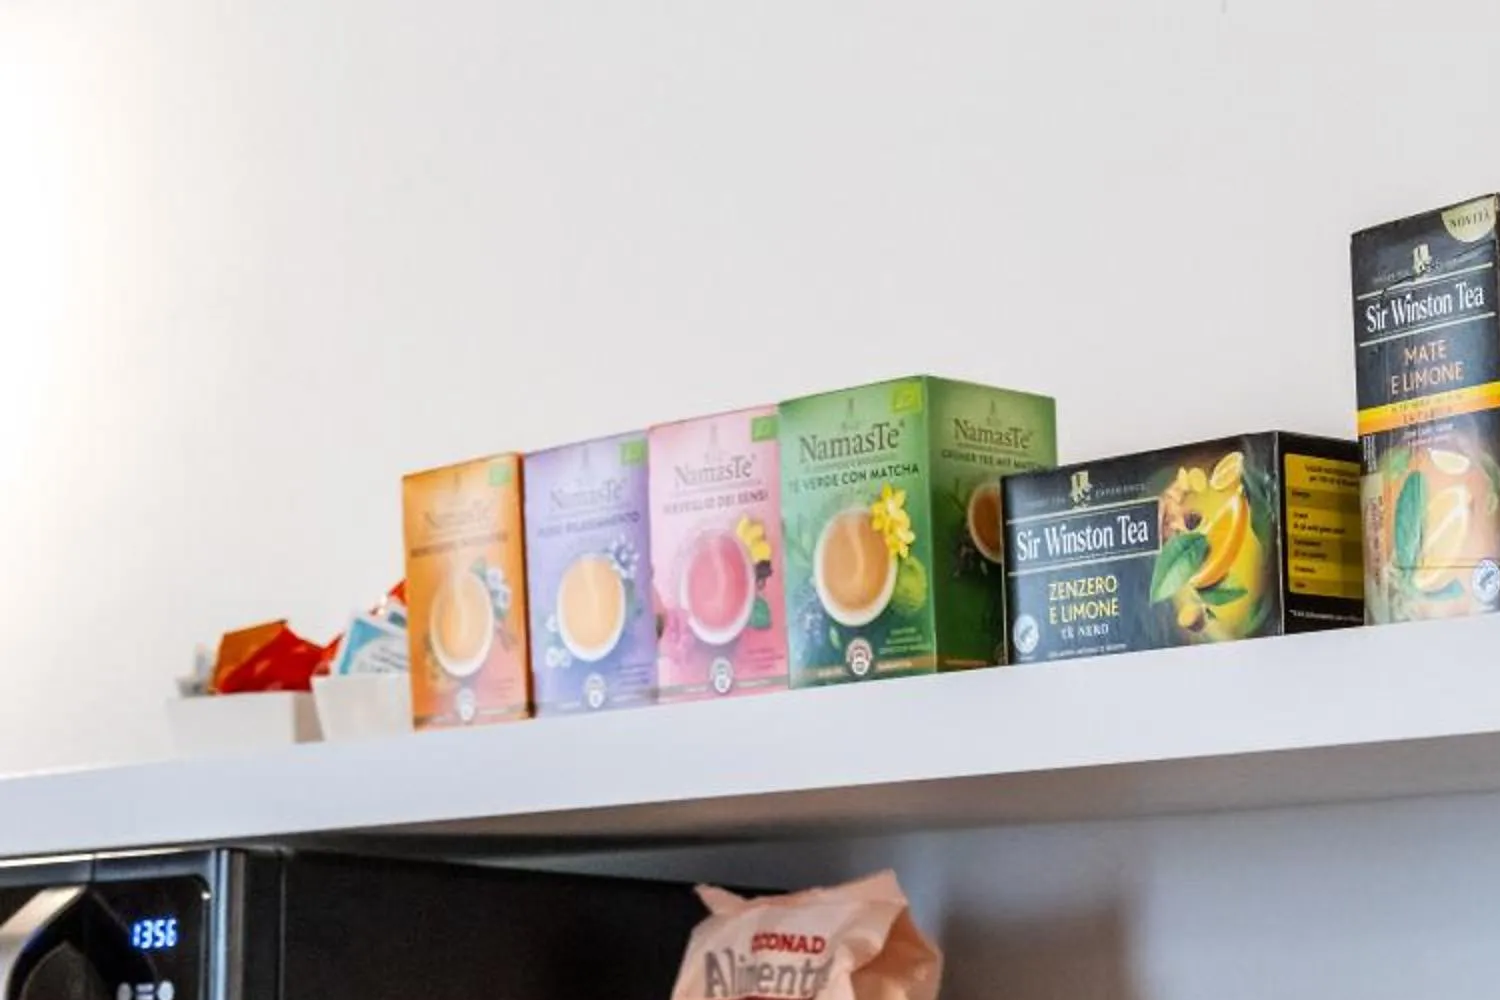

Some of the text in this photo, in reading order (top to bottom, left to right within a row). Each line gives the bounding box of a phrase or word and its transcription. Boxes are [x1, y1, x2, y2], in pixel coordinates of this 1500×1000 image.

[1366, 282, 1485, 333] Sir Winston Tea
[1404, 340, 1447, 366] MATE
[1391, 361, 1465, 395] E LIMONE
[803, 476, 840, 492] VERDE
[842, 470, 867, 486] CON
[870, 463, 920, 480] MATCHA
[1016, 515, 1149, 562] Sir Winston Tea
[1048, 575, 1118, 601] ZENZERO
[1049, 597, 1120, 625] E LIMONE
